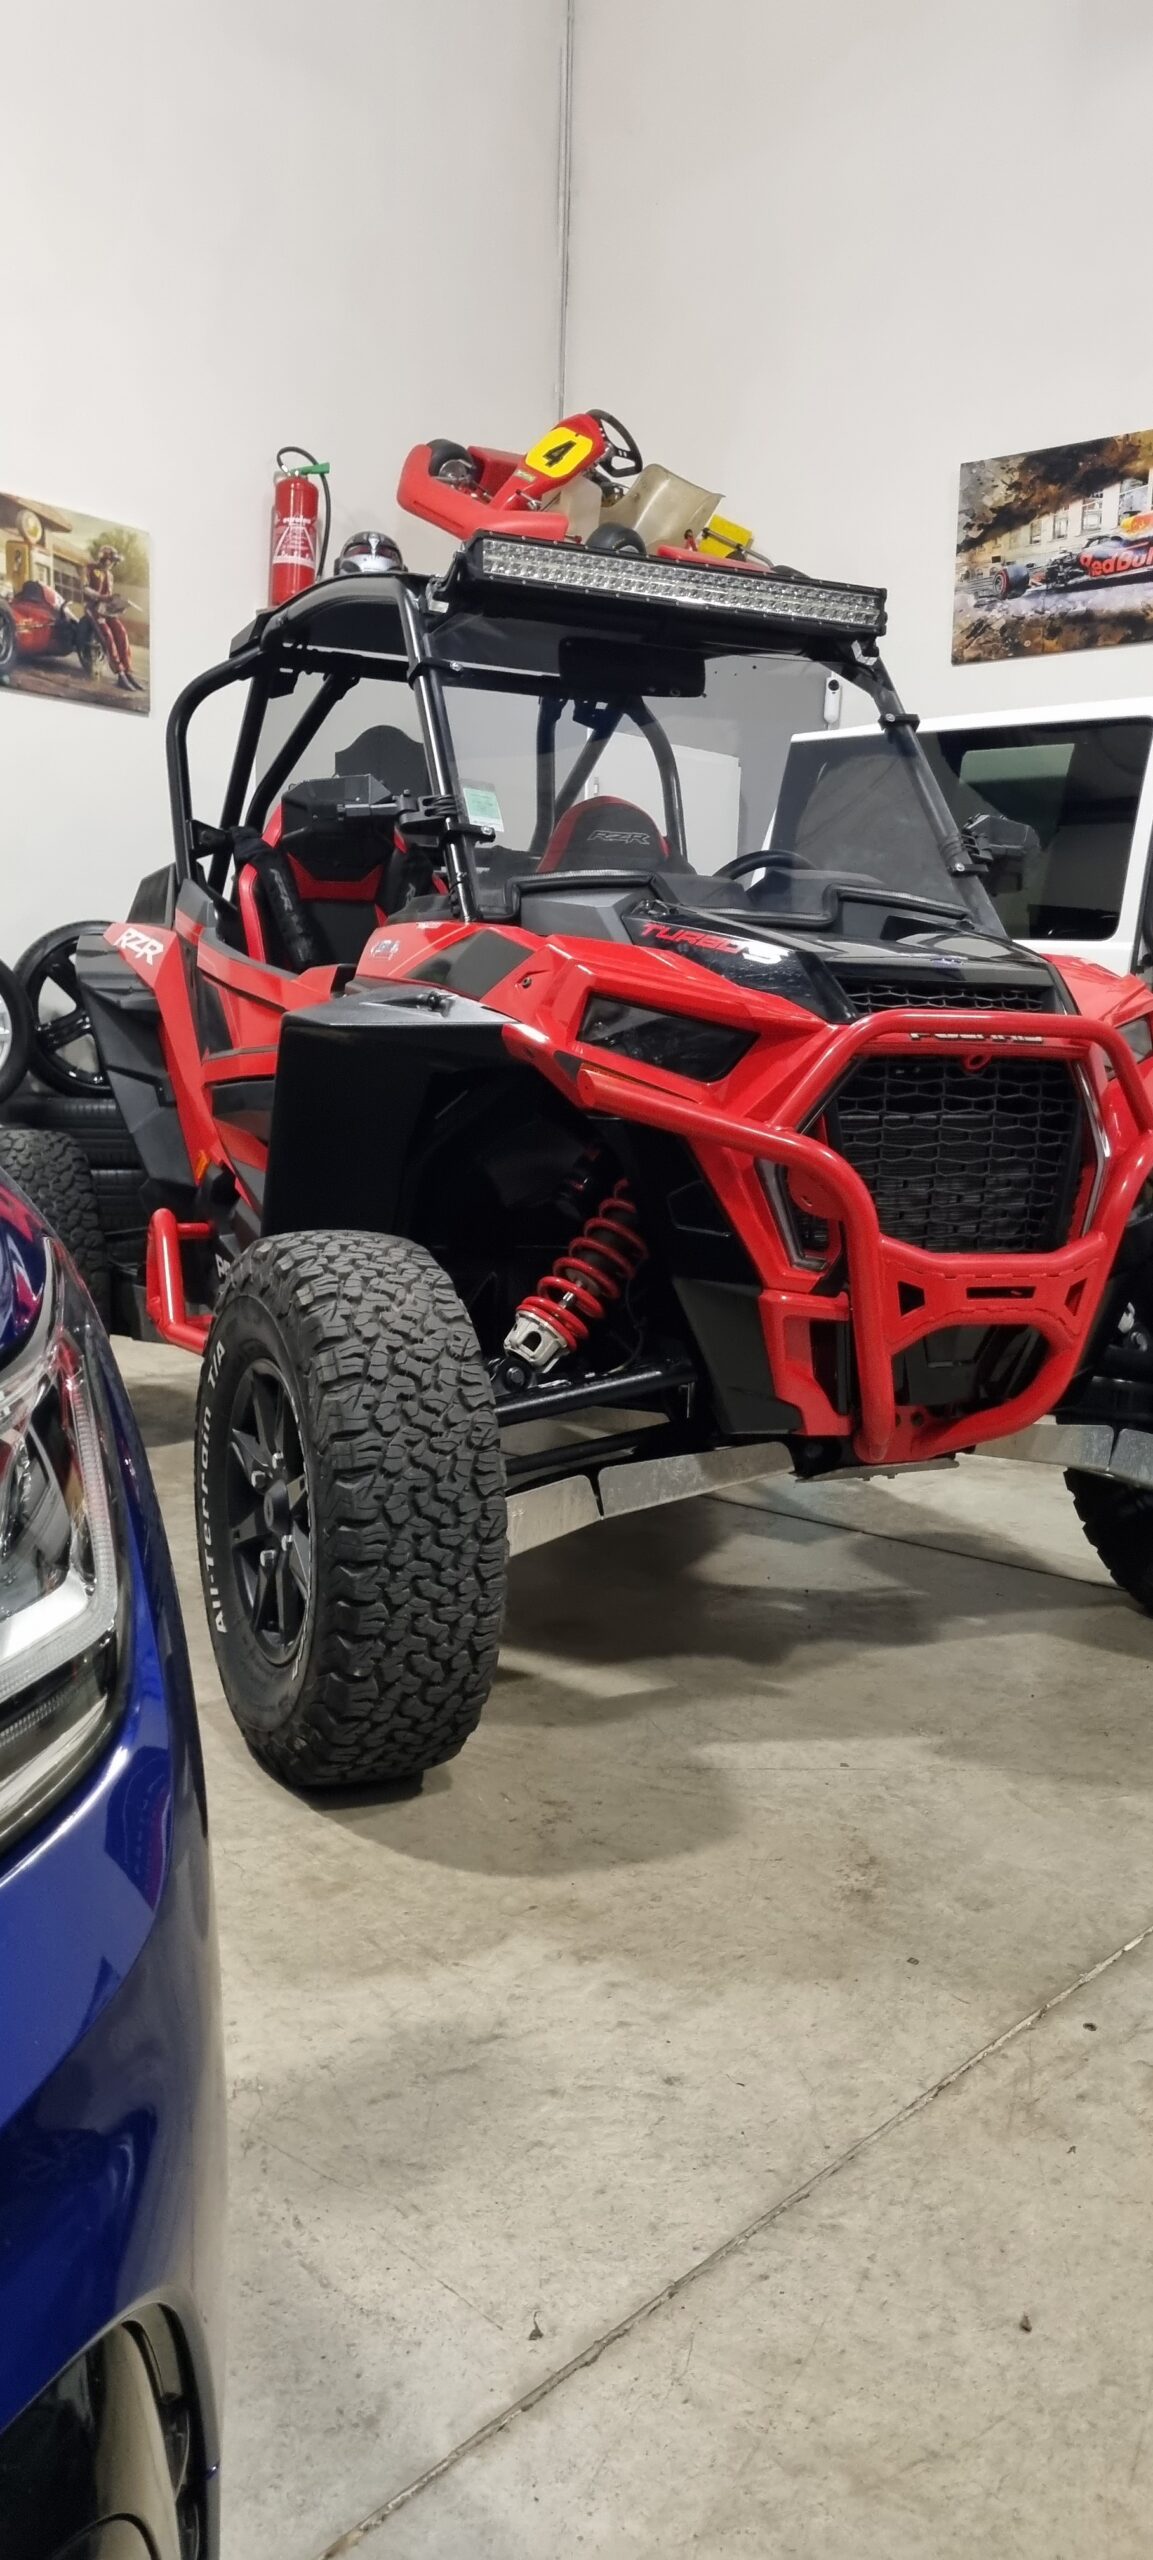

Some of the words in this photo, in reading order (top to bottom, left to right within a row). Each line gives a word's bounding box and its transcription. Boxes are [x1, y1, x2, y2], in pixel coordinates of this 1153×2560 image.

[542, 440, 577, 468] 4
[587, 830, 651, 845] RZR
[112, 927, 164, 966] RZR
[641, 922, 746, 954] TURBO
[207, 1340, 226, 1390] T/A
[202, 1405, 228, 1634] All-Terrain
